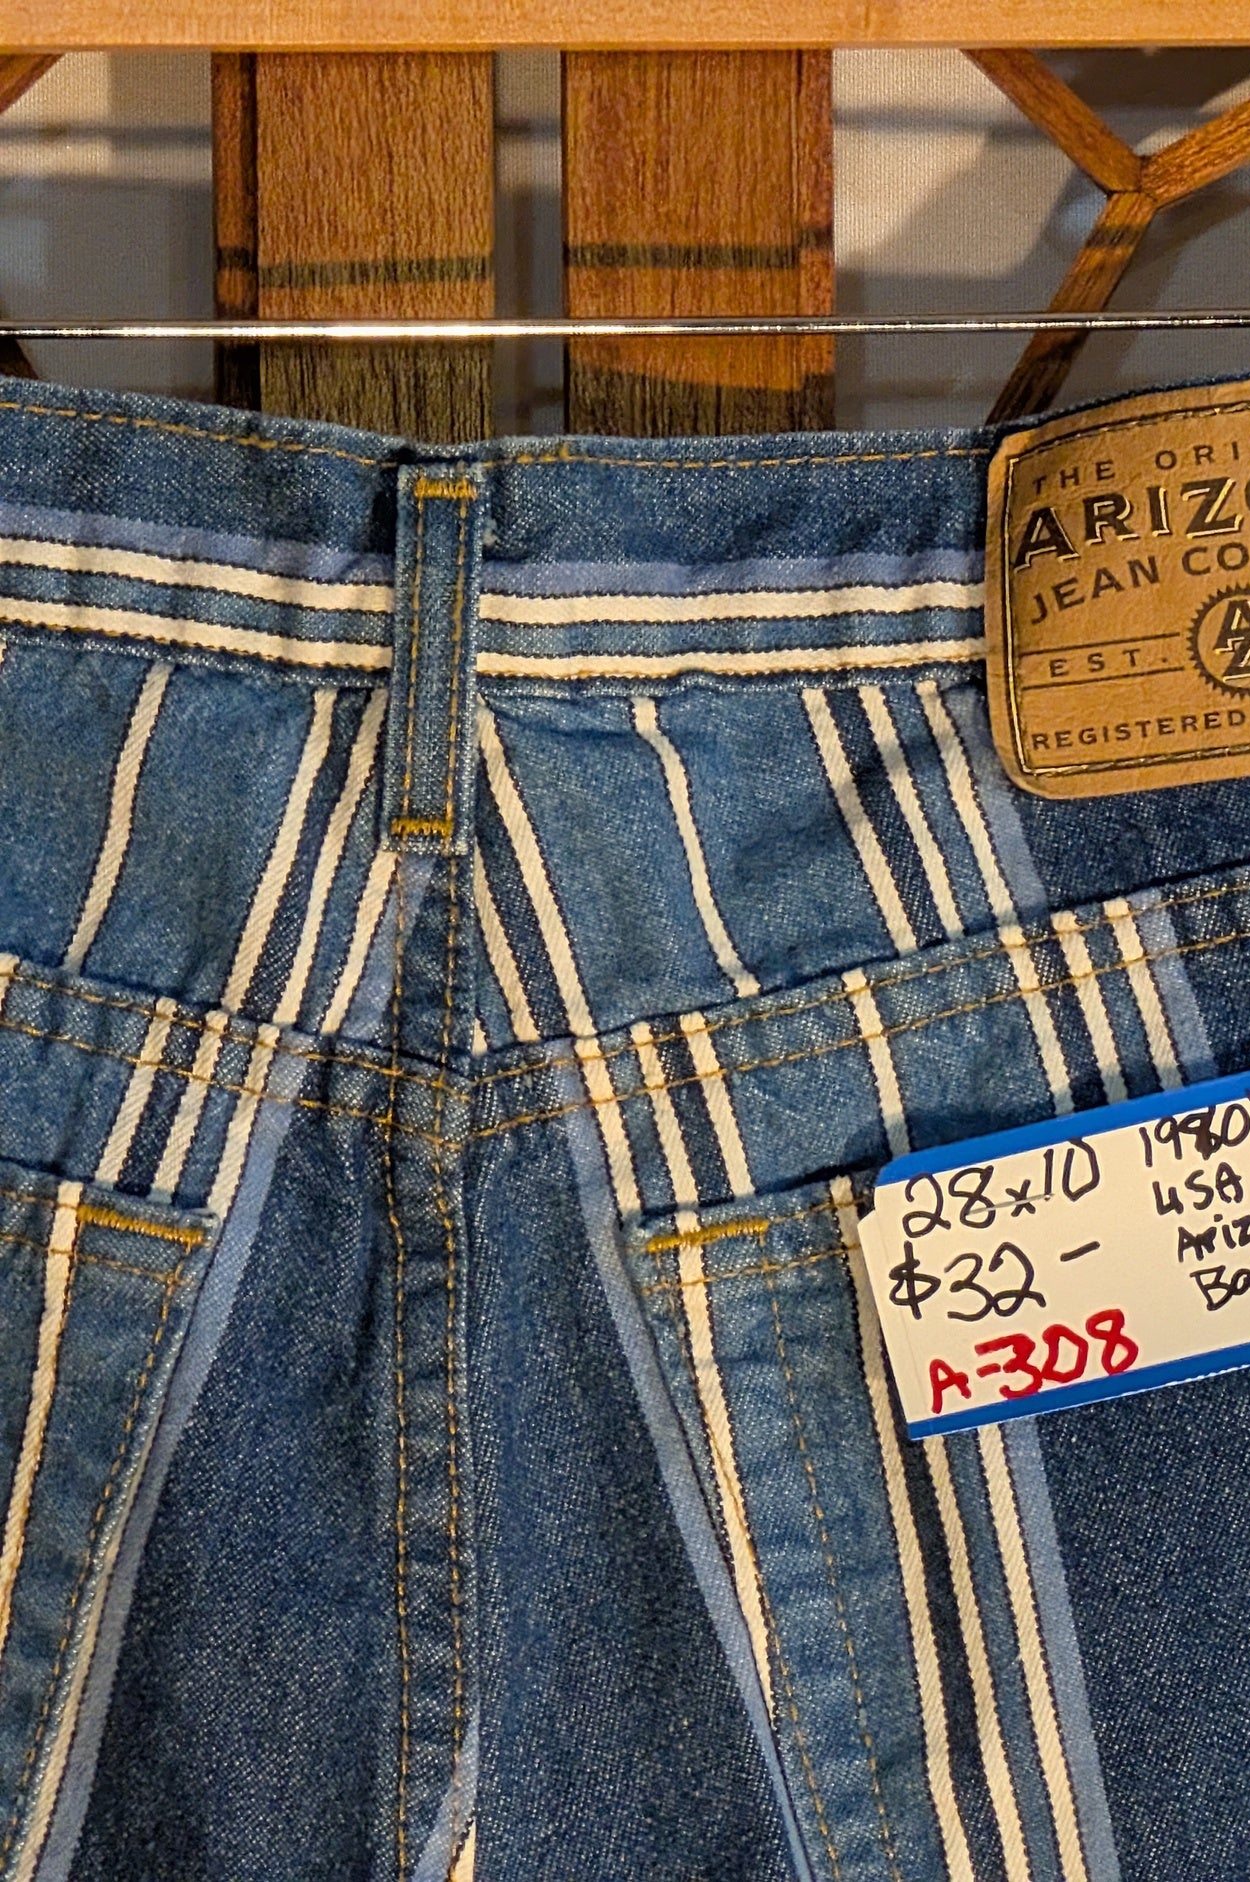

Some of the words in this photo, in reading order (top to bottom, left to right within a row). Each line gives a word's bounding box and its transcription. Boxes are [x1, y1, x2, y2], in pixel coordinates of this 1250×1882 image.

[1033, 460, 1116, 494] THE
[1031, 558, 1159, 624] JEAN
[1049, 649, 1168, 677] EST.
[1032, 709, 1247, 750] REGISTERED
